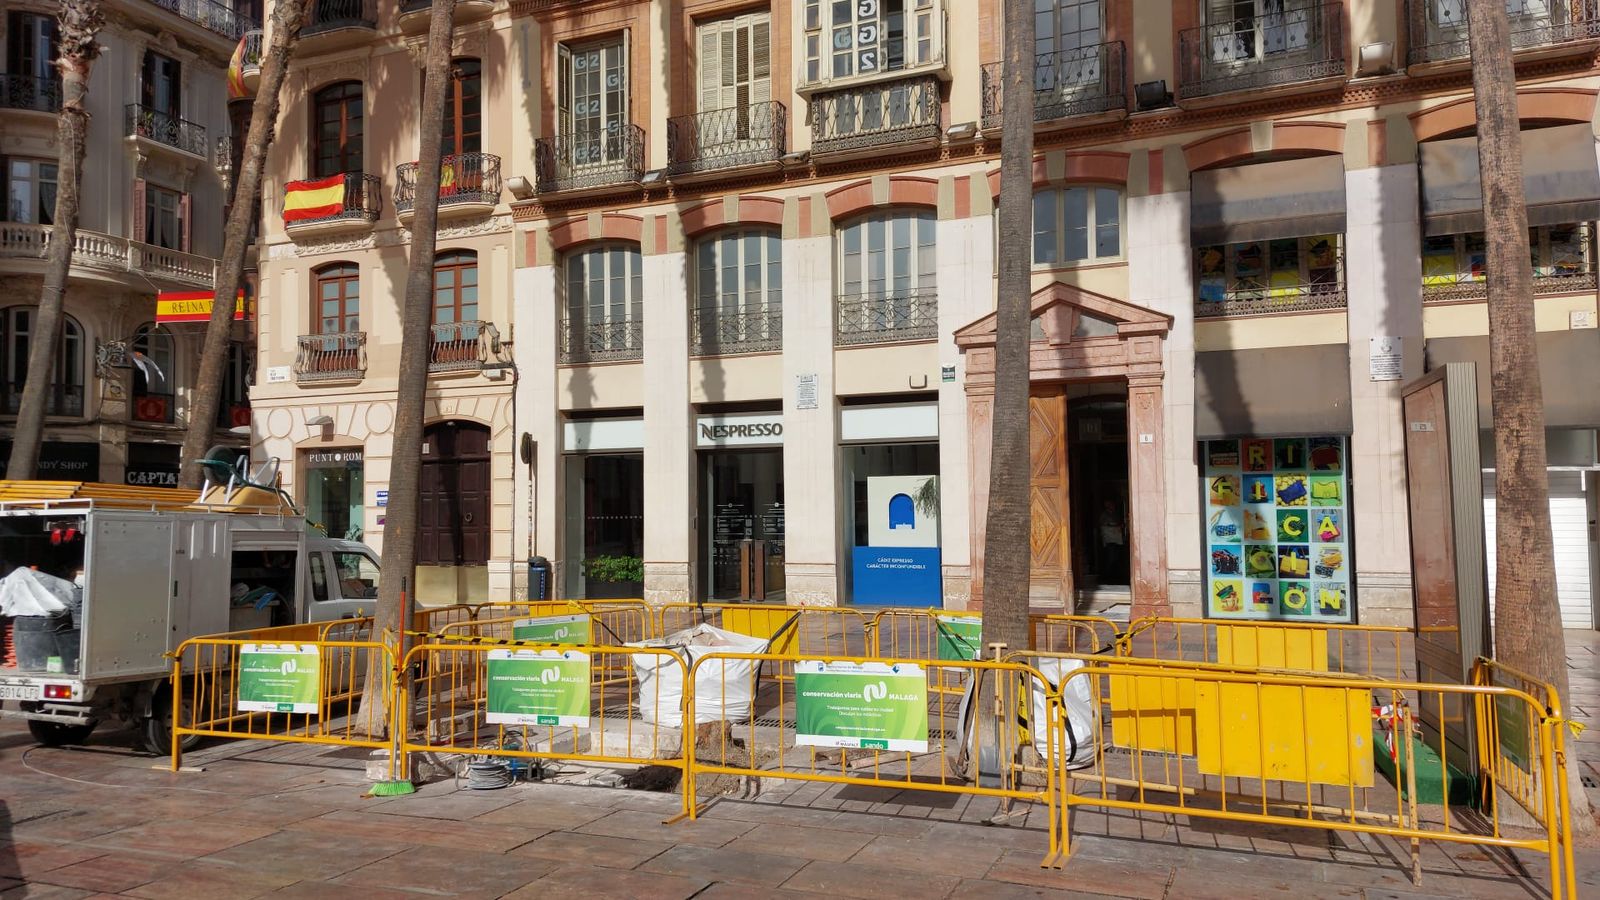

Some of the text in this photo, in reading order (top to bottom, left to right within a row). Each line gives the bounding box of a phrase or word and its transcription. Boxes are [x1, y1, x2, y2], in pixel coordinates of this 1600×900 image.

[171, 301, 205, 314] REINA
[699, 422, 783, 441] NESPRESSO
[60, 461, 88, 470] SHOP
